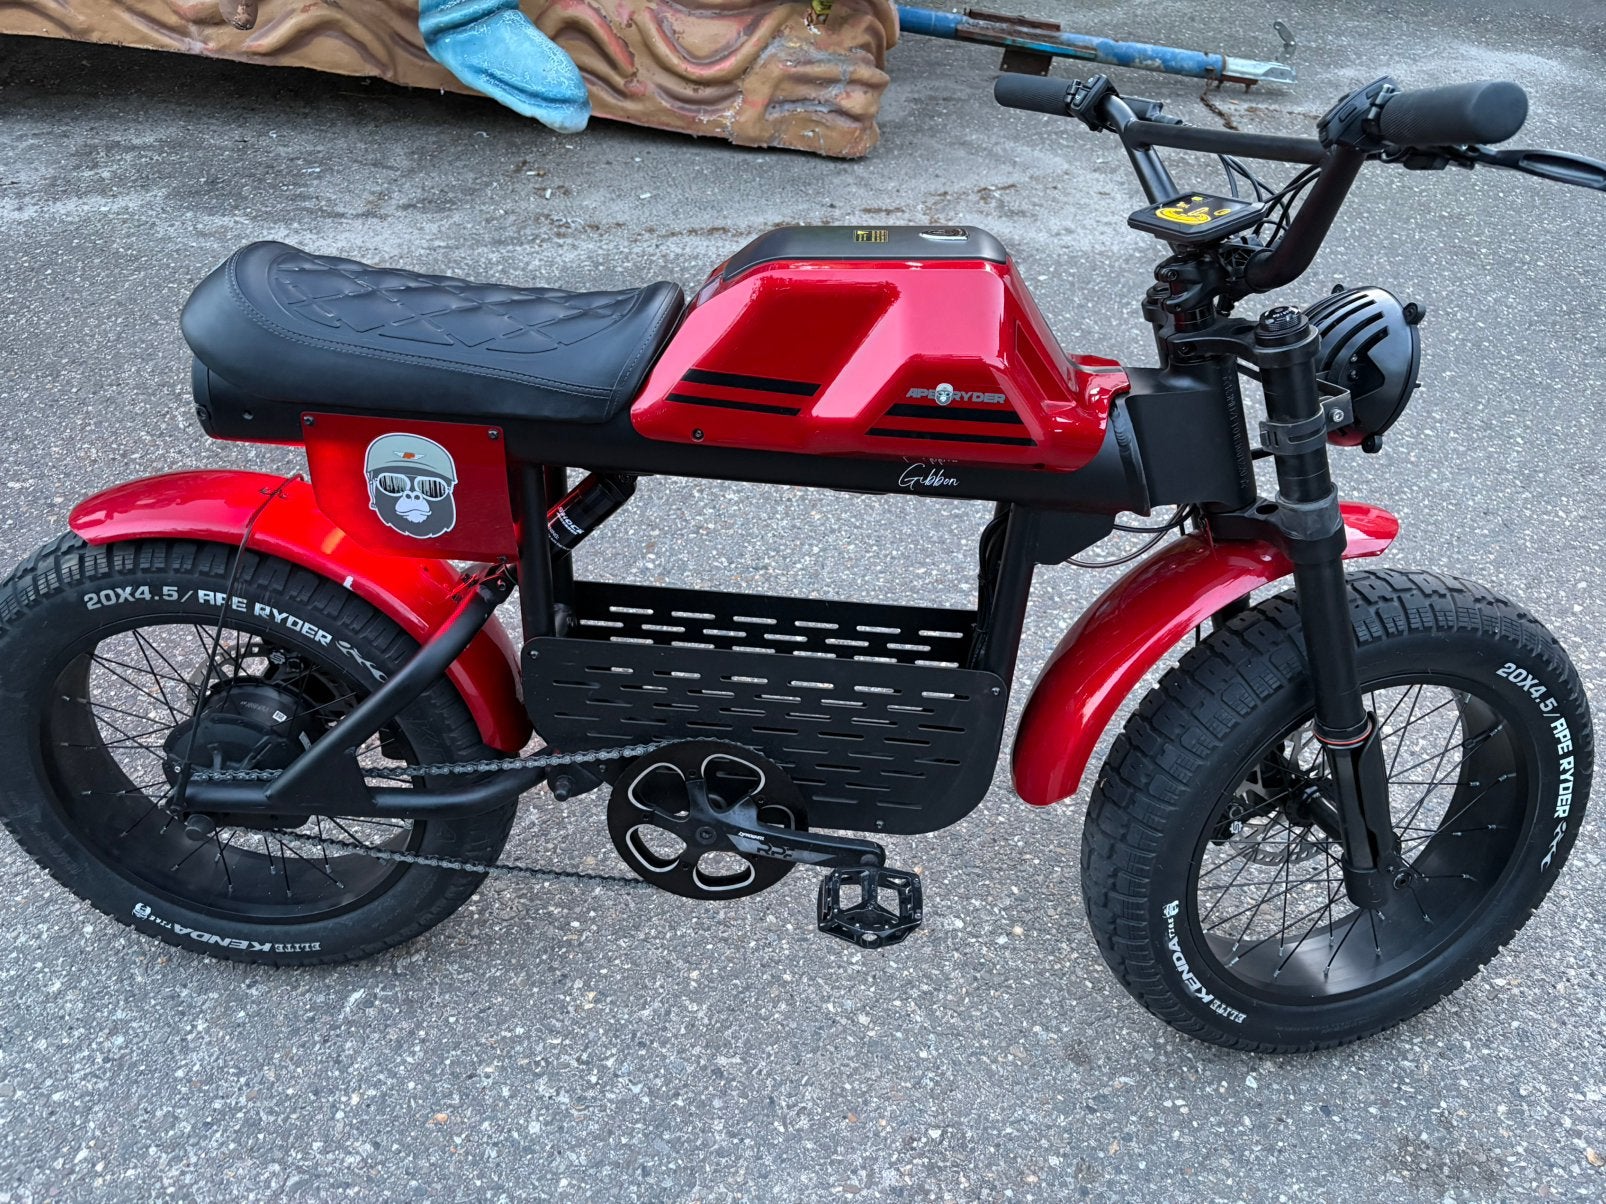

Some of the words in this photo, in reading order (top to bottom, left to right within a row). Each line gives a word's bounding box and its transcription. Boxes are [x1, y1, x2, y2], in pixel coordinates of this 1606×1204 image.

[951, 390, 1006, 404] RYDER
[898, 462, 960, 491] Gibbon
[254, 602, 333, 648] RYDER
[1554, 755, 1575, 819] RYDER
[173, 923, 273, 952] KENDA
[274, 942, 322, 953] ELITE
[1168, 936, 1214, 1003] KENDA
[1210, 999, 1248, 1024] ELITE
